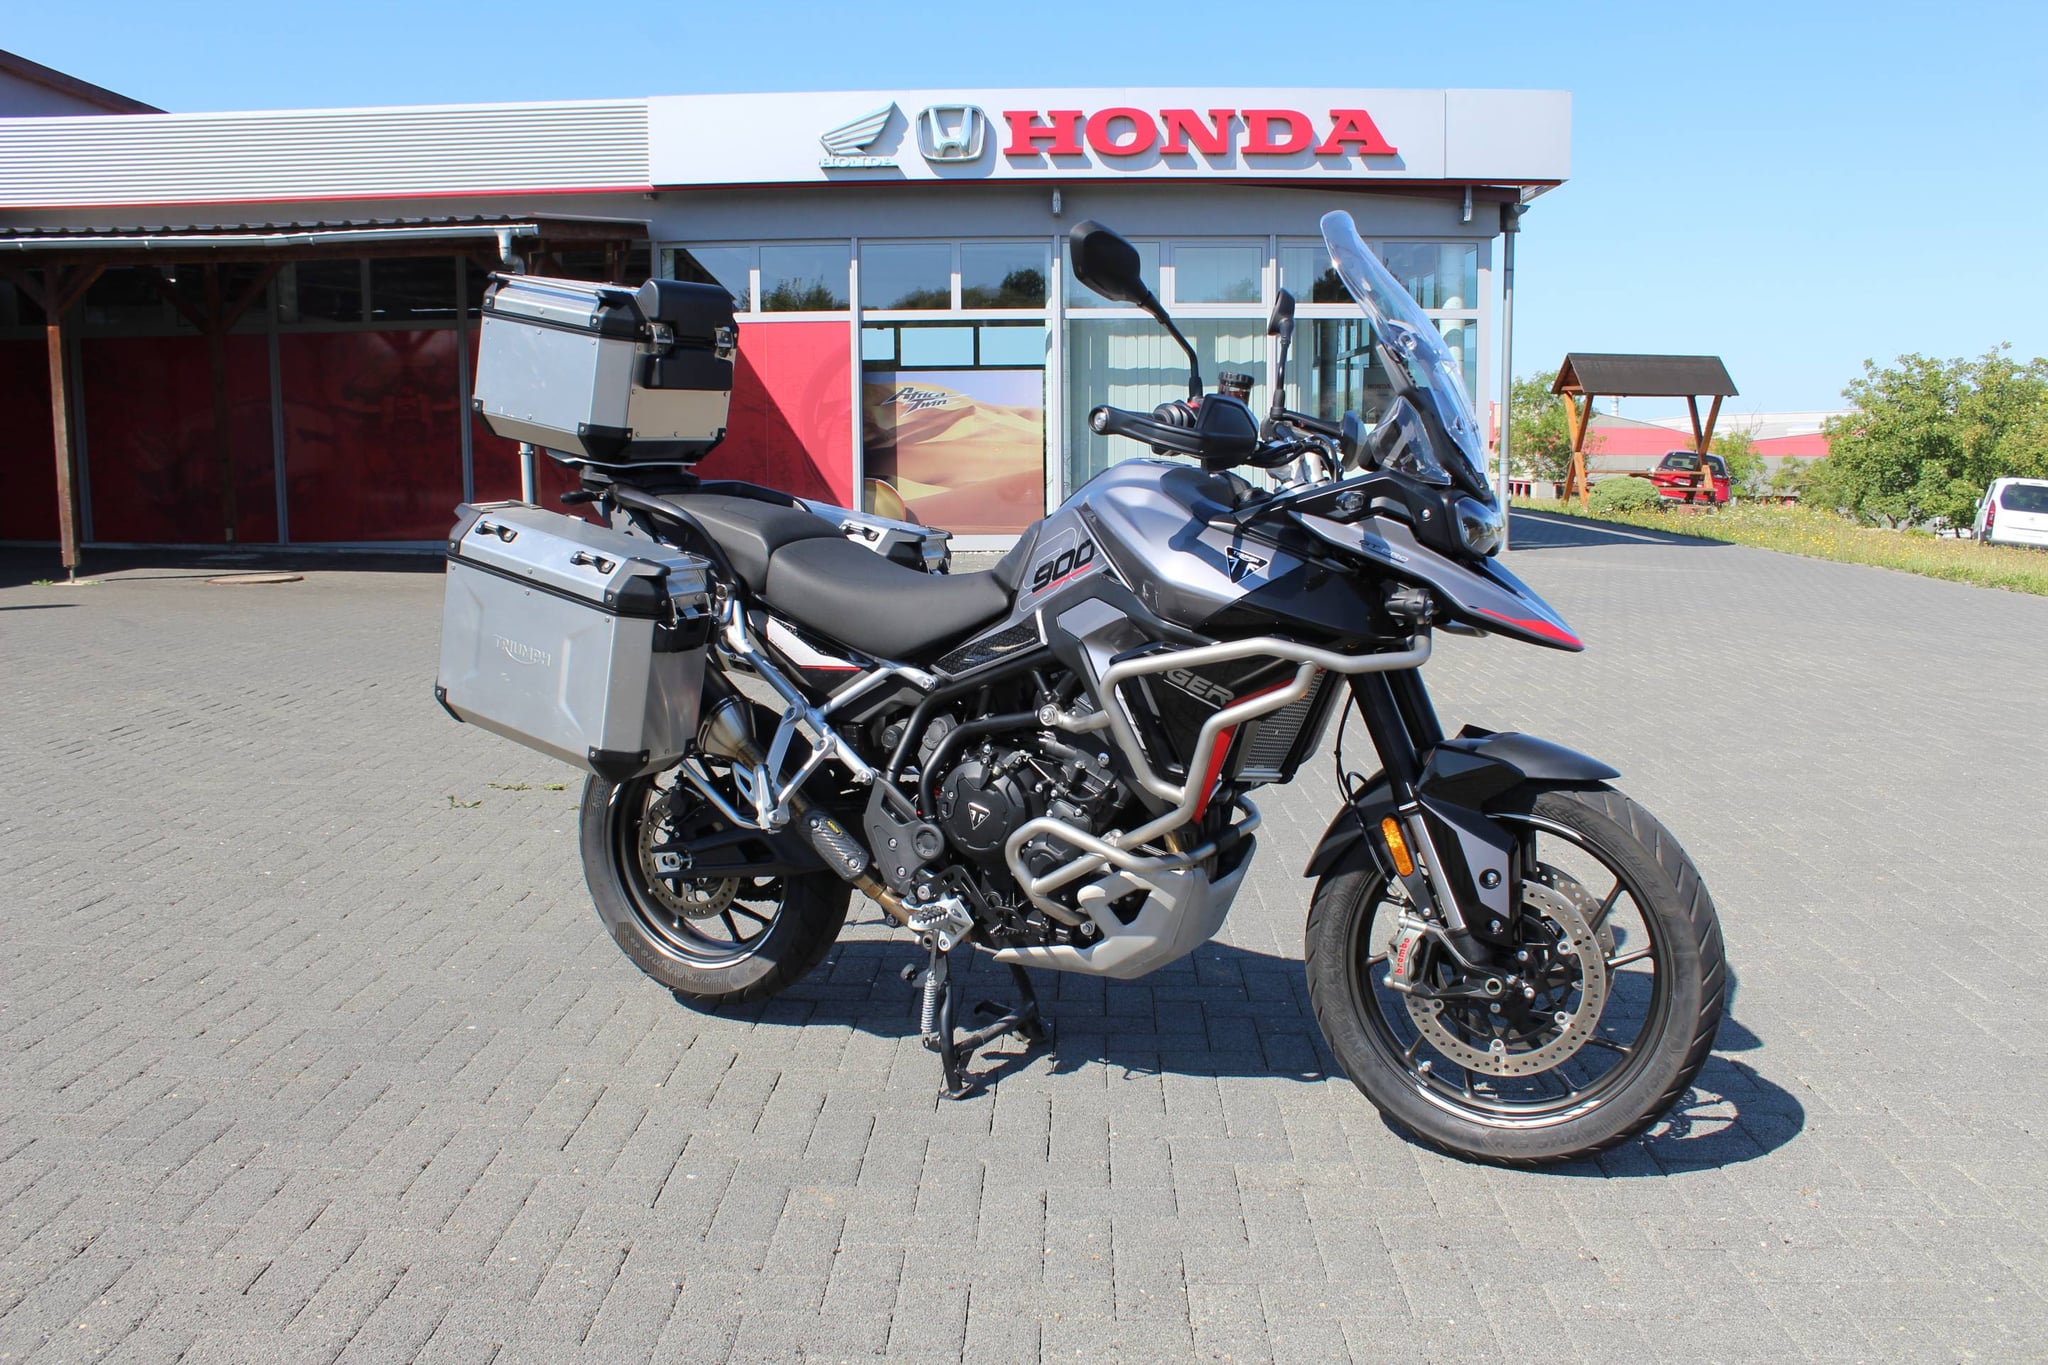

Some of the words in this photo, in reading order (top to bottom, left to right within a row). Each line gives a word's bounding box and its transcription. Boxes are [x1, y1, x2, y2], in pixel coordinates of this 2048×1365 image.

[1003, 107, 1397, 156] HONDA
[818, 156, 898, 168] HONDA
[881, 387, 946, 406] Africa
[901, 399, 947, 417] Twin
[1031, 538, 1095, 593] 900
[493, 633, 551, 666] TRIUMPH
[1157, 668, 1235, 707] GER
[1395, 937, 1411, 975] brembo
